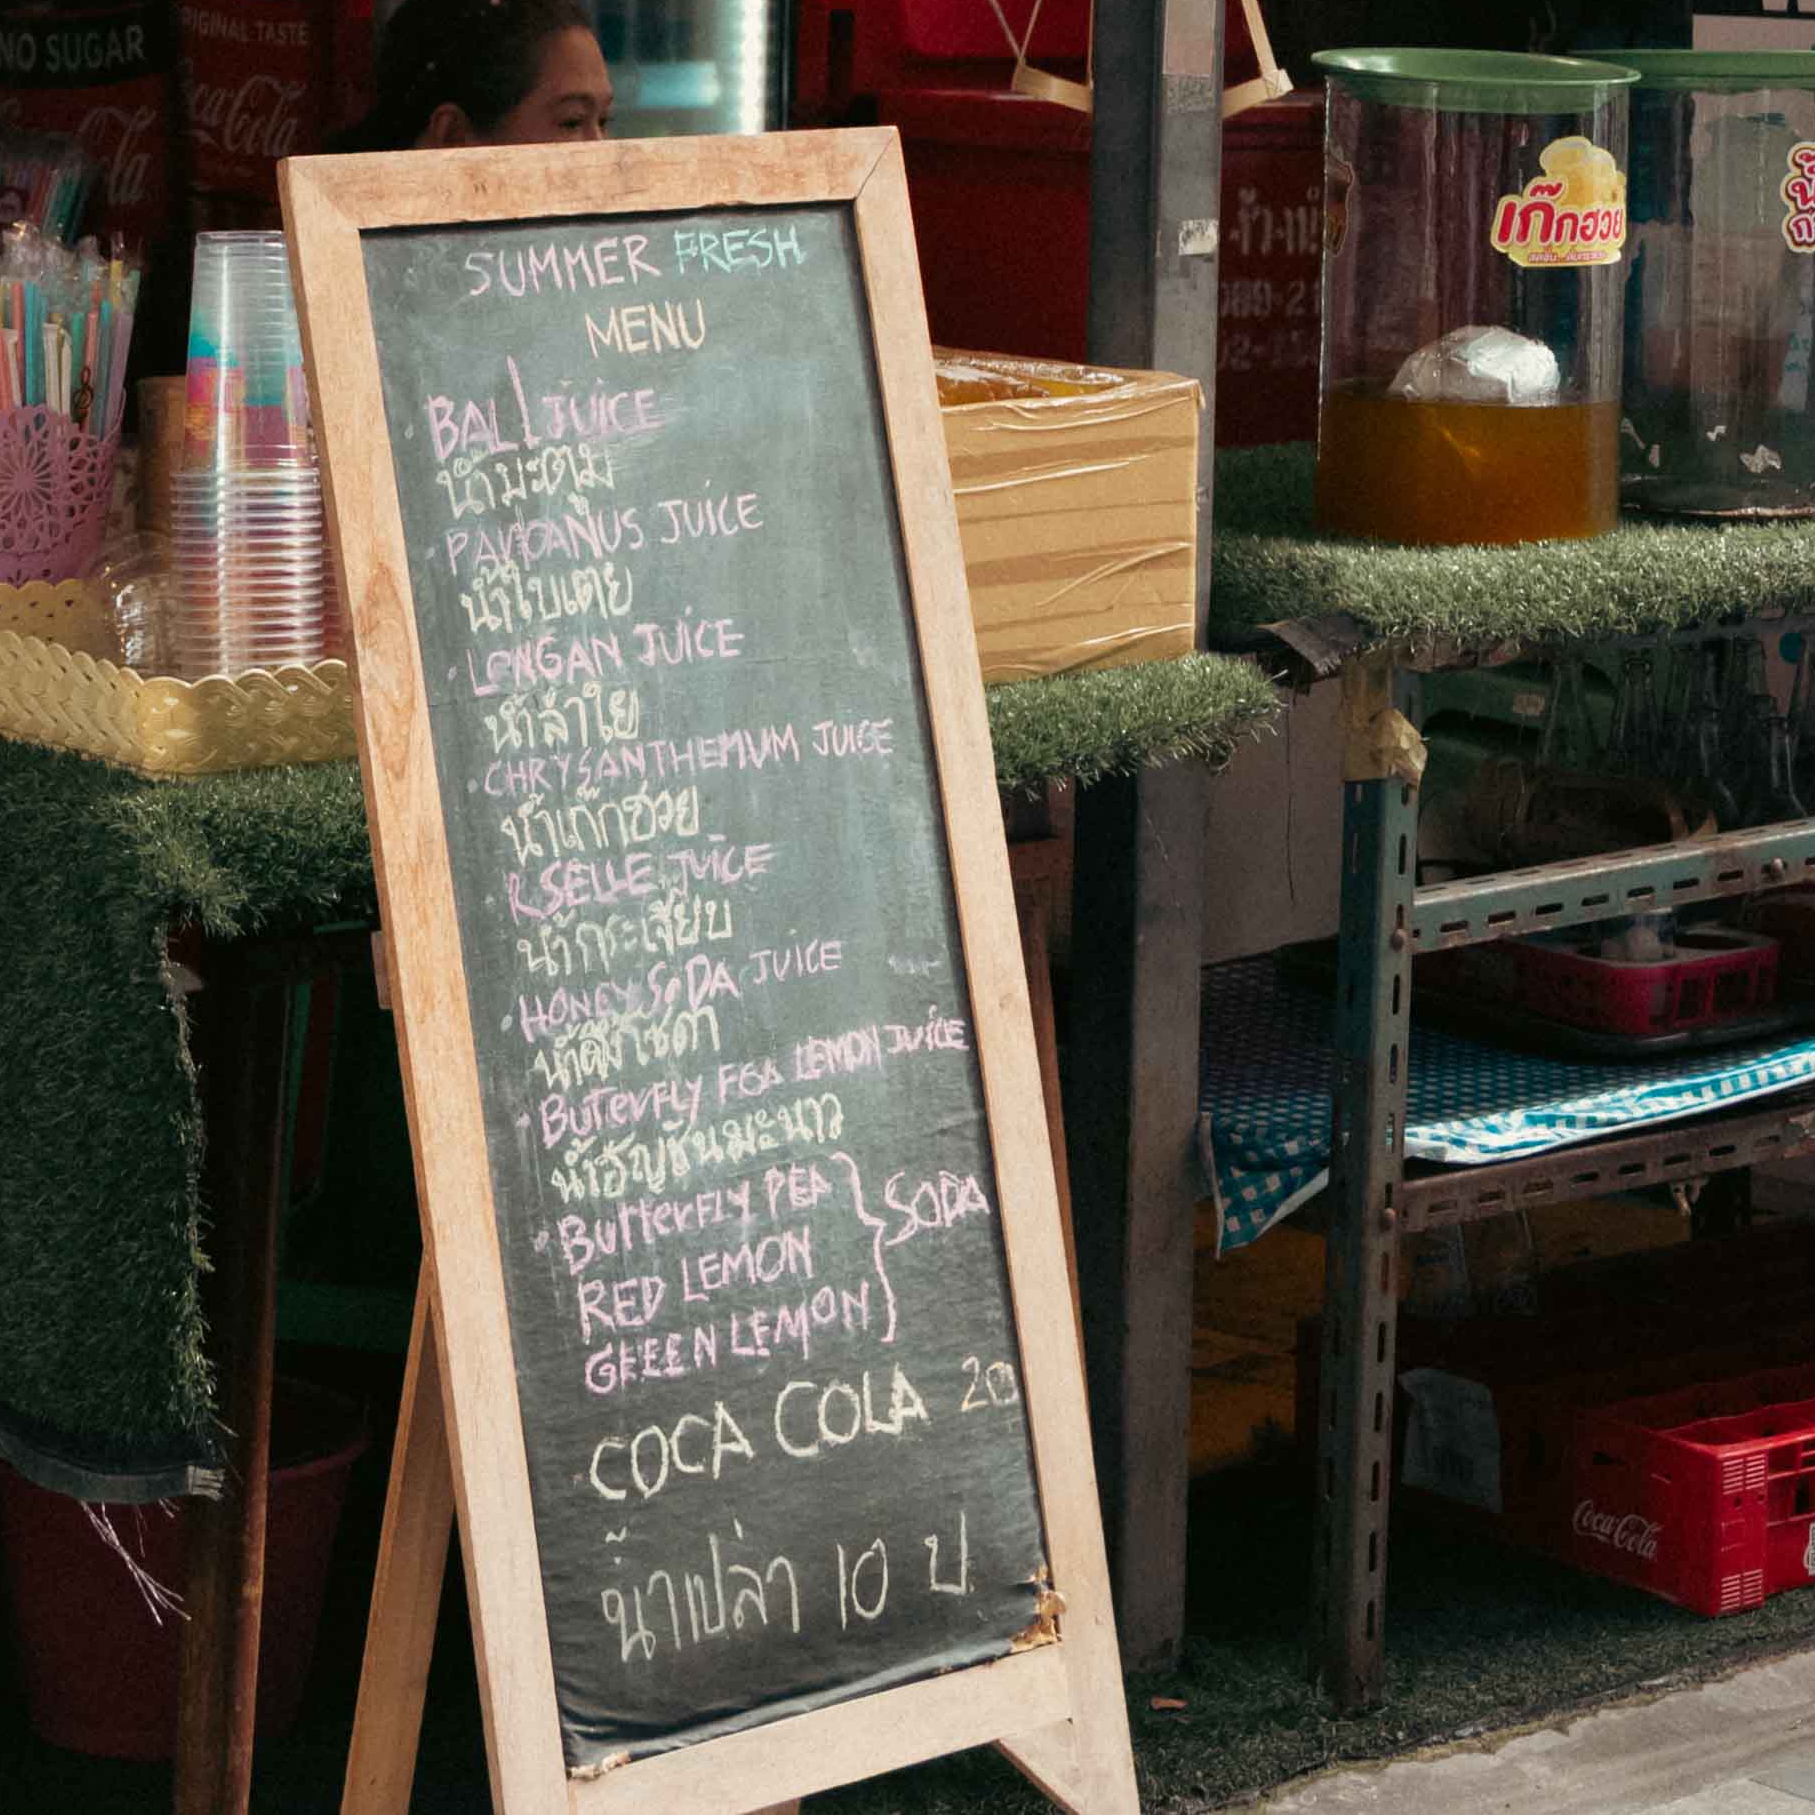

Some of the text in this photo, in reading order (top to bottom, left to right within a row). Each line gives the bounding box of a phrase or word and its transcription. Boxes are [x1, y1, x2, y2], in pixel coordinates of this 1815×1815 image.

[45, 25, 146, 73] SUGAR
[1496, 181, 1623, 244] เก๊กฮวย
[464, 223, 807, 298] SUMMER FRESH
[585, 297, 707, 359] MENU
[541, 378, 665, 441] JUICE
[658, 479, 763, 545] JUICE
[466, 607, 745, 696] LONGAN JUICE
[811, 717, 895, 757] JUICE
[667, 835, 780, 897] JUICE
[646, 953, 742, 1012] SODA
[748, 929, 842, 985] JUICE
[883, 1169, 991, 1246] SODA
[578, 1225, 815, 1345] RED LEMON
[731, 1281, 870, 1360] LEMON
[588, 1355, 1018, 1502] COCA COLA 20
[836, 1538, 890, 1633] 10
